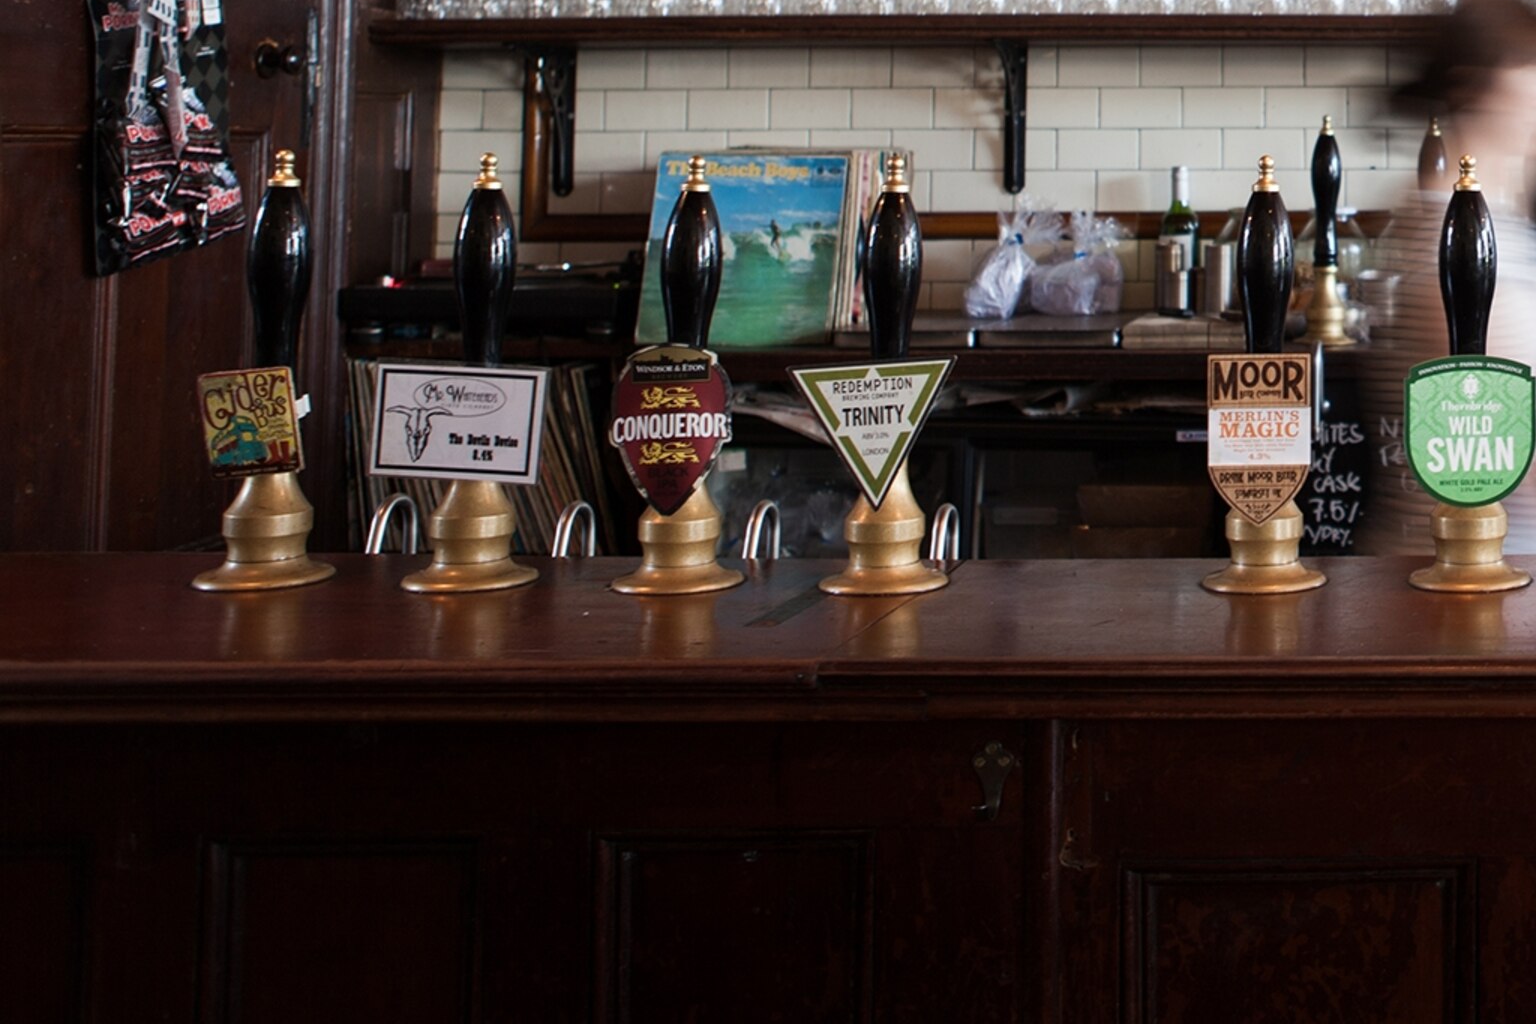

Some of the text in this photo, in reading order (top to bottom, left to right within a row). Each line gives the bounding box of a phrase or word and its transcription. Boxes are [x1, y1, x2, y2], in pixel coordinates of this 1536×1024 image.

[705, 161, 810, 180] Beach Boys
[635, 363, 706, 374] WINDSOR & ETON
[833, 377, 912, 394] REDEMPTION
[1213, 361, 1304, 401] MOOR
[204, 373, 286, 431] Cider
[842, 392, 899, 401] BREWING COMPANY
[252, 395, 287, 428] Bus
[842, 404, 905, 427] TRINITY
[1441, 400, 1503, 414] Thornbridge
[1219, 410, 1299, 422] MERLIN'S
[613, 413, 727, 443] CONQUEROR
[1219, 422, 1299, 439] MAGIC
[1448, 415, 1492, 436] WILD
[449, 433, 463, 445] The
[862, 448, 890, 457] LONDON
[1426, 436, 1514, 473] SWAN
[1248, 471, 1274, 484] MOOR
[1276, 471, 1298, 484] BEER
[1313, 472, 1362, 493] CASK
[1460, 478, 1475, 486] GOLD
[1477, 478, 1492, 486] PALE
